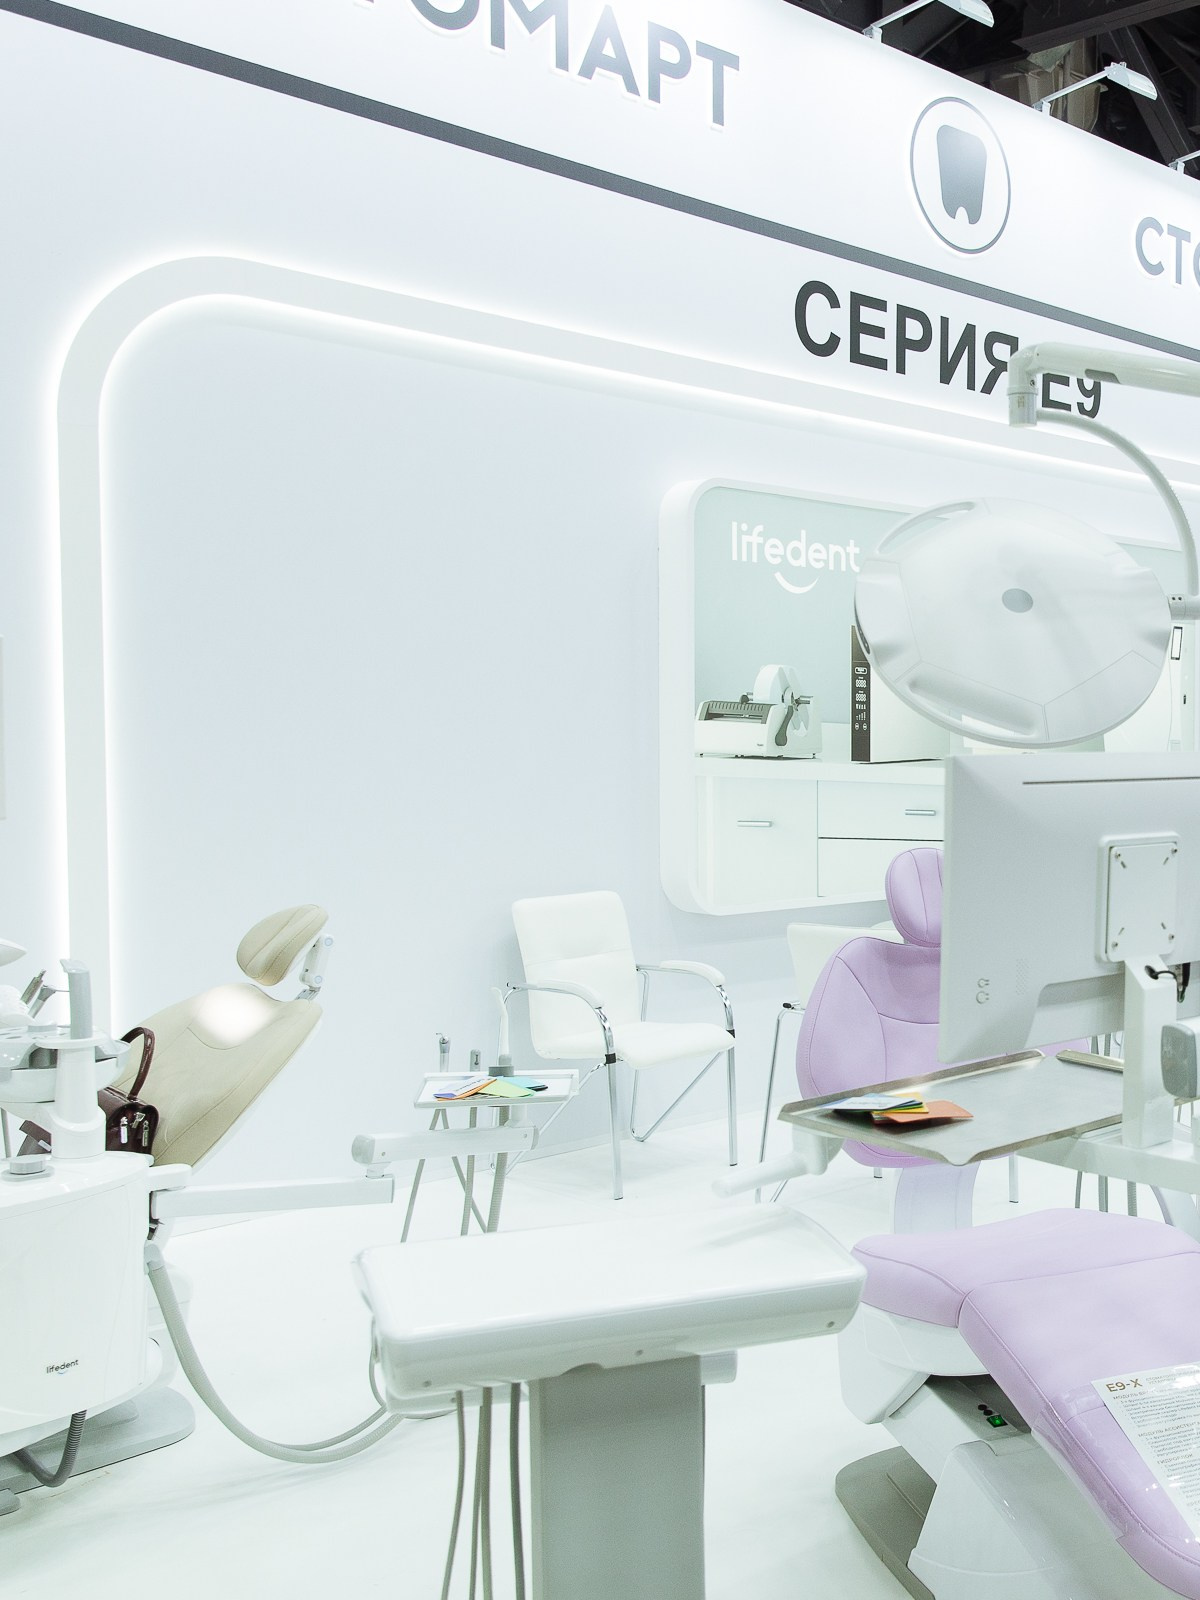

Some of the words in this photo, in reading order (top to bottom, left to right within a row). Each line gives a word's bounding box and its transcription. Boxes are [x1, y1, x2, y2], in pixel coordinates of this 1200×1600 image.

[354, 0, 740, 127] МАРТ
[794, 280, 1019, 396] СЕРИЯ
[731, 521, 860, 573] lifedent
[46, 1359, 79, 1374] lifedent
[1106, 1378, 1143, 1393] E9-X
